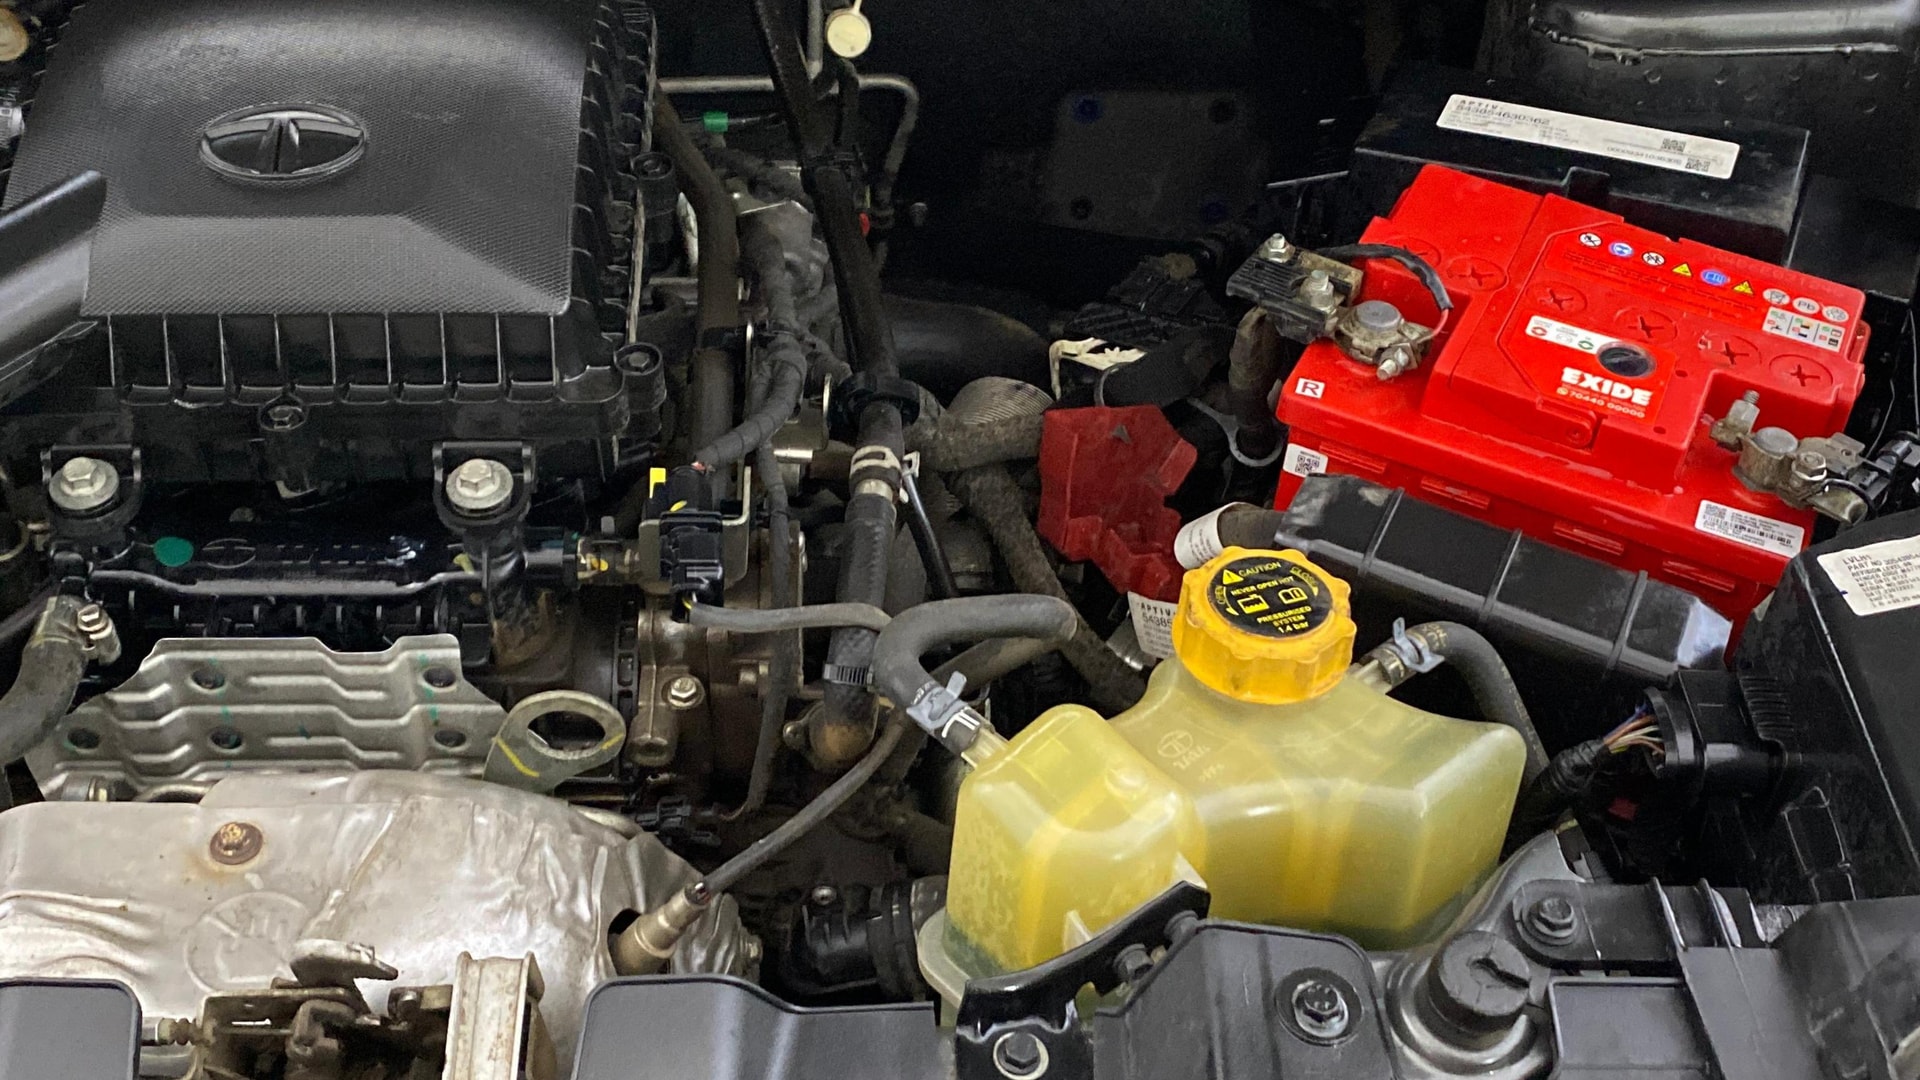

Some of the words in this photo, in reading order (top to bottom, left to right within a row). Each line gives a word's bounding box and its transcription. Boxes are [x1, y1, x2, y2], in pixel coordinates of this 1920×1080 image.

[1797, 301, 1815, 312] Pb
[1300, 381, 1320, 396] R
[1561, 366, 1653, 406] EXIDE
[1239, 562, 1281, 577] CAUTION
[1848, 560, 1869, 571] PART
[1230, 585, 1257, 596] NEVER
[1257, 580, 1278, 590] OPEN
[1256, 605, 1312, 624] PRESSURISED
[1272, 614, 1305, 627] SYSTEM
[1278, 625, 1293, 633] 1.4
[1292, 621, 1309, 630] bar
